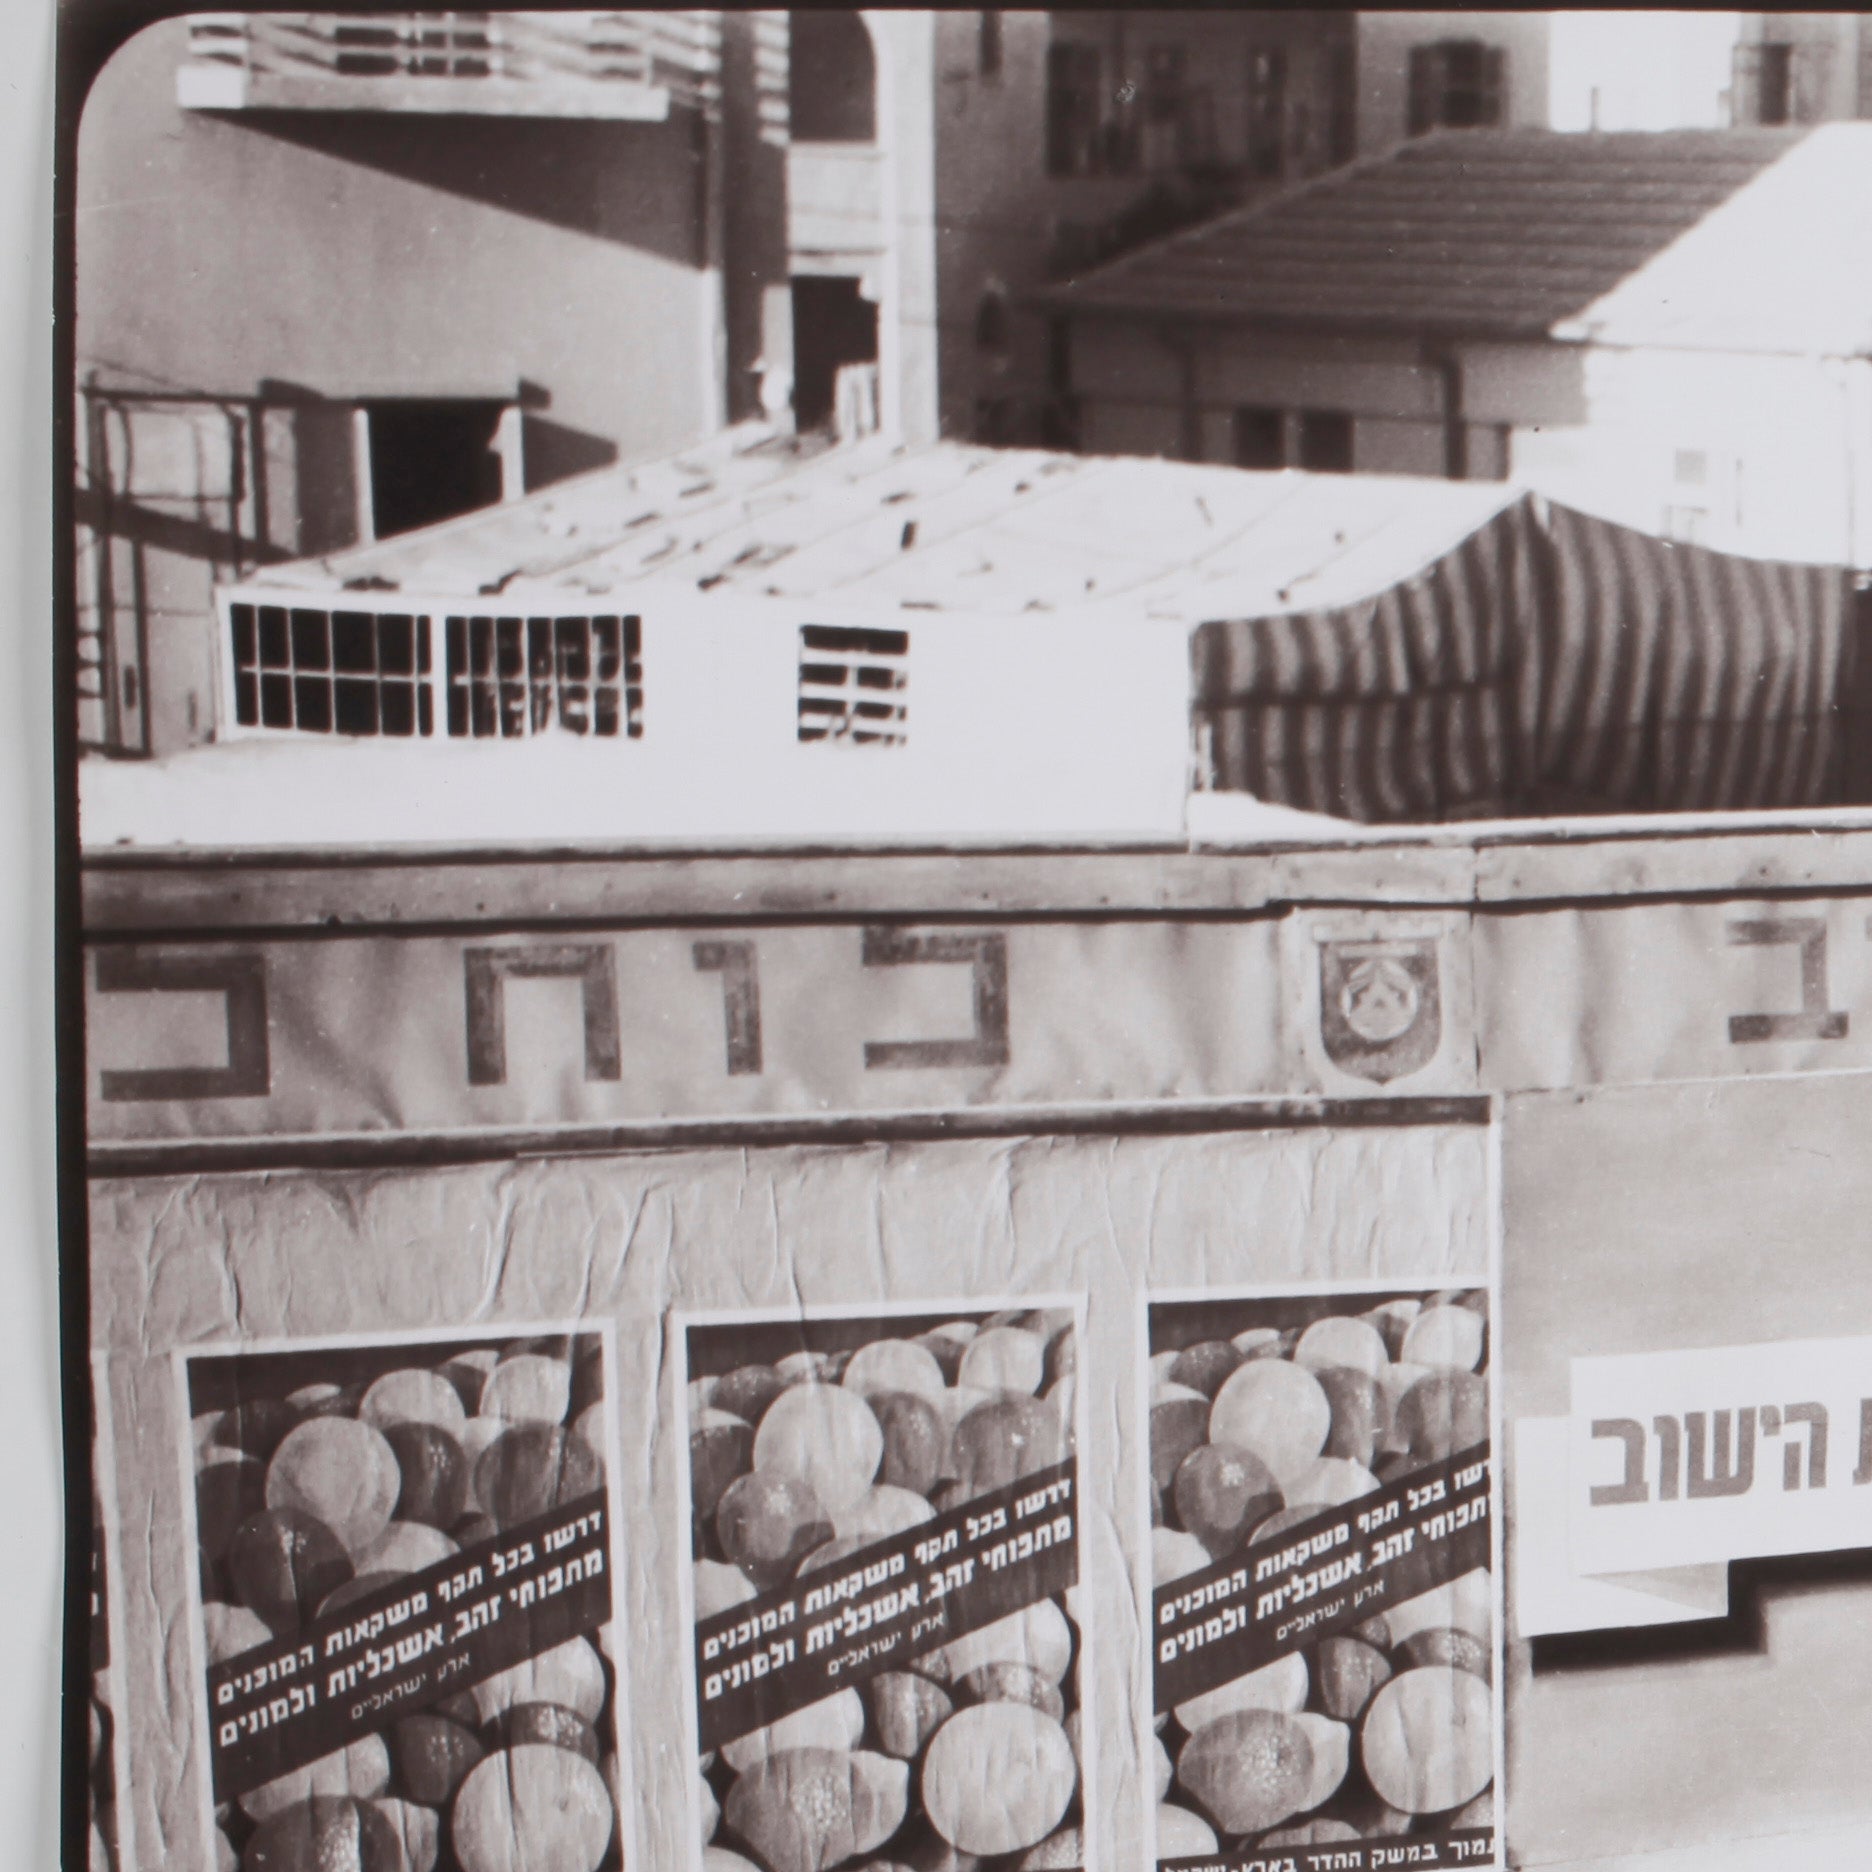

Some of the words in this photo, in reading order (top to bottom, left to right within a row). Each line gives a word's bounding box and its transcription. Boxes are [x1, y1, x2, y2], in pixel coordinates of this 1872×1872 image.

[1590, 1401, 1829, 1506] הישוב
[966, 1508, 1007, 1541] בכל
[1408, 1479, 1446, 1511] בכל
[492, 1542, 534, 1577] בכל
[544, 1511, 601, 1553] דרשו
[981, 1515, 1072, 1572] מתפוחי
[1256, 1523, 1349, 1582] משקאות
[510, 1549, 603, 1609] מתפוחי
[804, 1553, 905, 1614] משקאות
[1160, 1569, 1247, 1625] המוכנים
[1256, 1552, 1362, 1621] אשכליות
[326, 1592, 428, 1656] משקאות
[703, 1601, 796, 1660] המוכנים
[805, 1586, 919, 1653] אשכליות
[1160, 1606, 1247, 1663] ולמונים
[217, 1645, 314, 1705] המוכנים
[328, 1624, 443, 1697] אשכליות
[704, 1639, 796, 1699] ולמונים
[220, 1683, 315, 1746] ולמונים
[1308, 1852, 1361, 1871] ההדר
[1371, 1843, 1438, 1869] במשק
